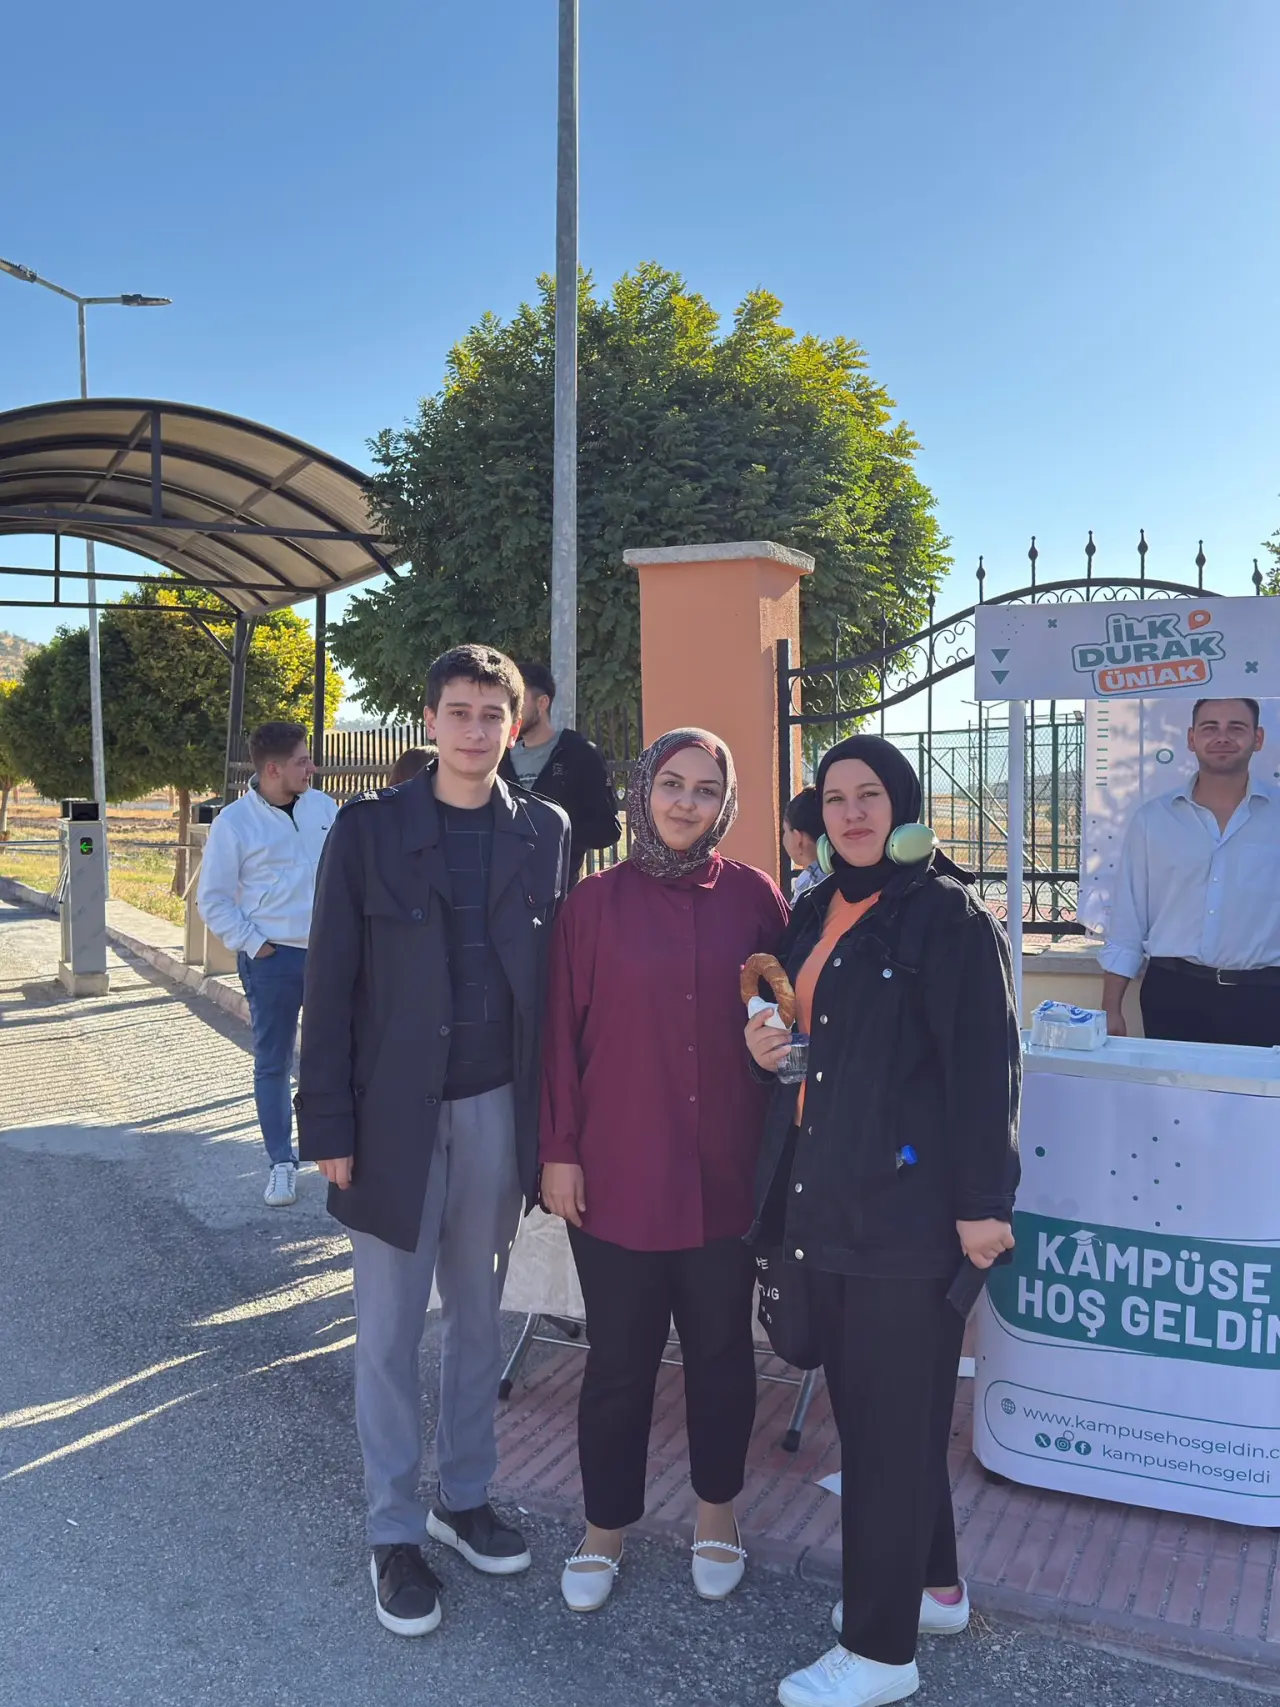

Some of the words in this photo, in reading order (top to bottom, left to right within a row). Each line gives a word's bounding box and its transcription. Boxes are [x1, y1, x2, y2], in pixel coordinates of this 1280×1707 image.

[1112, 618, 1177, 643] İLK
[1079, 636, 1218, 668] DURAK
[1105, 664, 1198, 690] ÜNİAK
[1018, 1276, 1106, 1338] HOŞ
[1102, 1444, 1270, 1484] kampusehosgeldi
